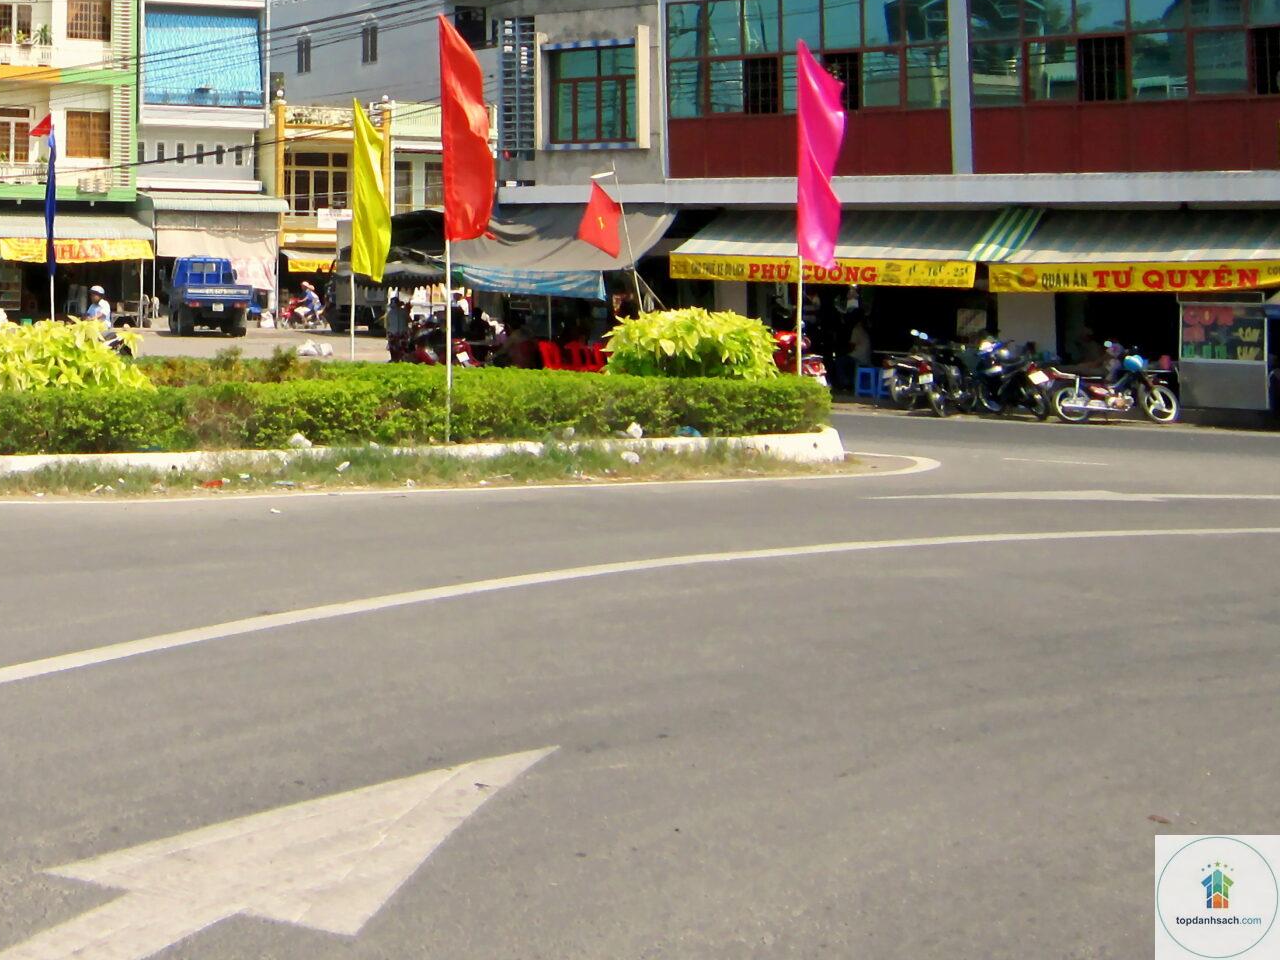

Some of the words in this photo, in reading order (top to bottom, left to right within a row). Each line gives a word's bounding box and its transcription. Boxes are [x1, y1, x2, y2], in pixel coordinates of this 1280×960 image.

[748, 259, 791, 281] PHÚ
[1041, 269, 1070, 290] QUÁN
[1093, 266, 1136, 289] TƯ
[1142, 264, 1260, 290] QUYÊN
